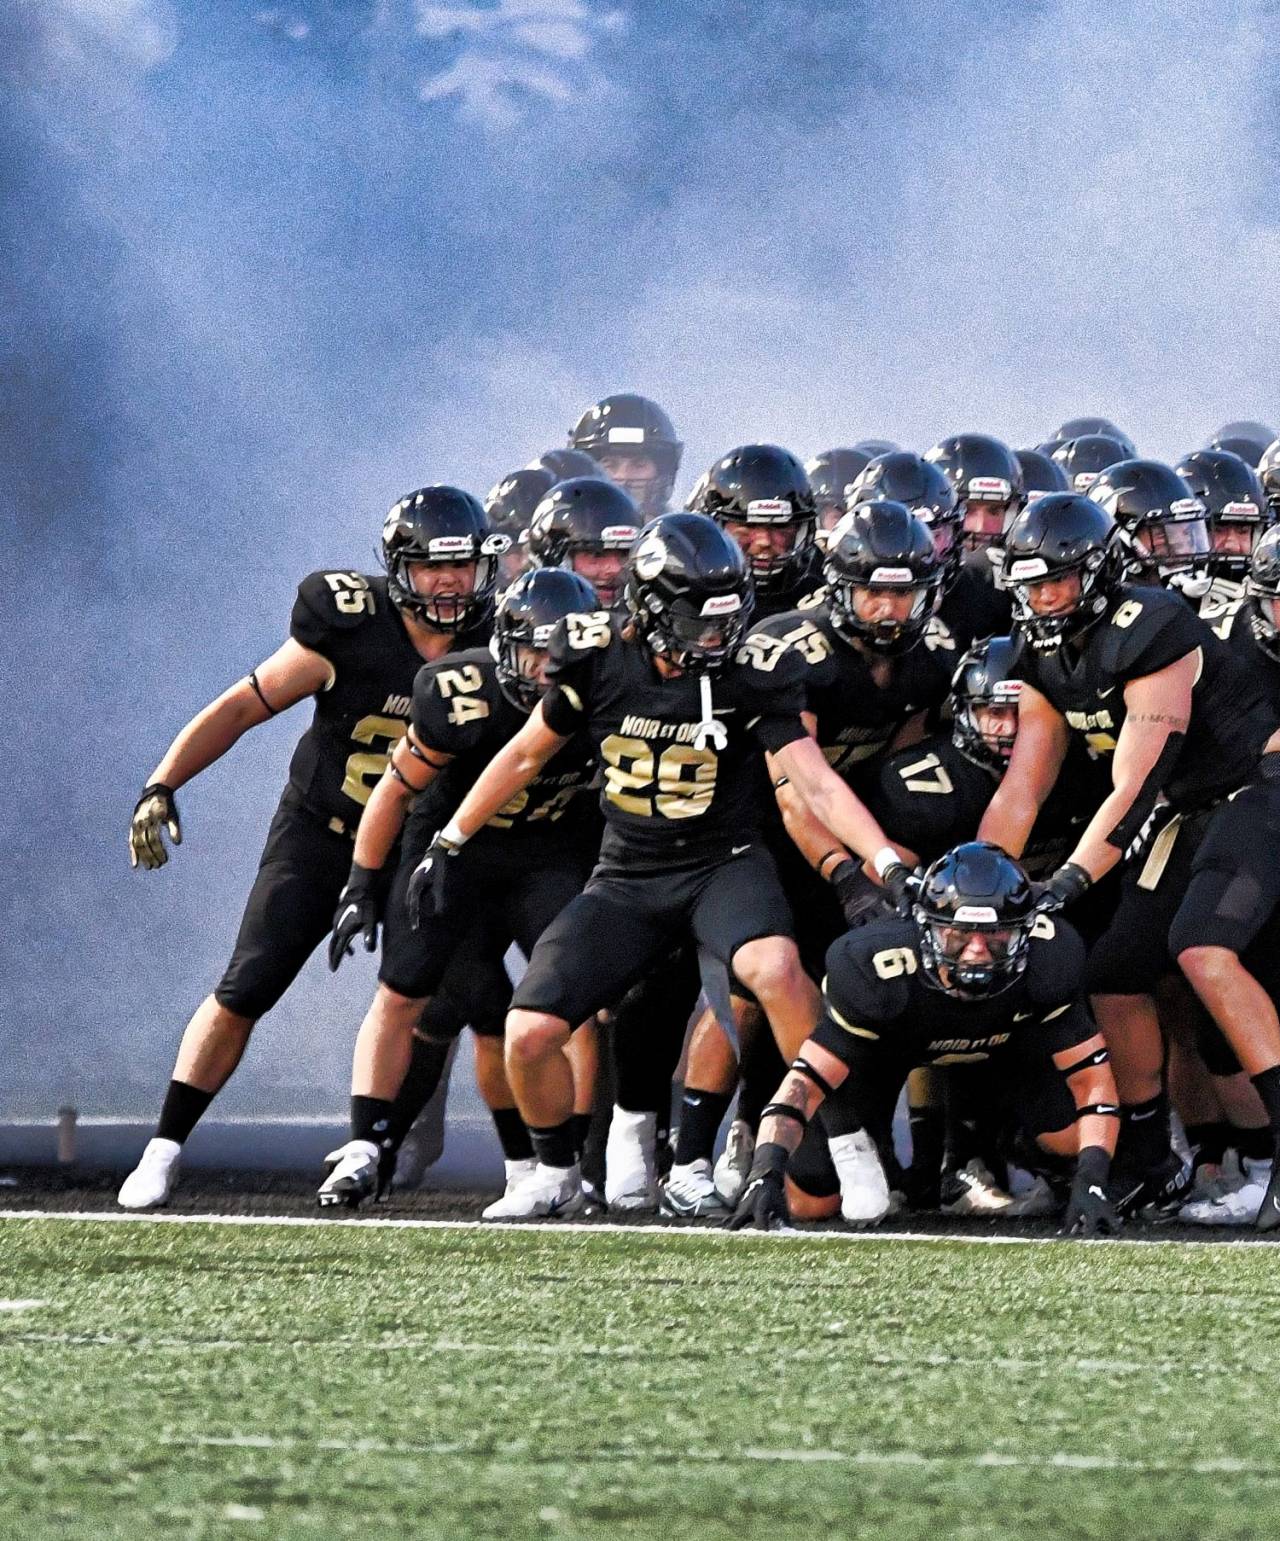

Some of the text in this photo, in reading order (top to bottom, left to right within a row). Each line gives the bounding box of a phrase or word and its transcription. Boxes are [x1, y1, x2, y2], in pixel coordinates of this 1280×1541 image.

[1230, 505, 1256, 513] Riddell
[324, 572, 376, 615] 25
[566, 611, 611, 651] 29
[435, 664, 489, 726] 24
[620, 714, 661, 737] NOIR
[660, 726, 677, 737] ET
[601, 733, 718, 820] 29
[898, 752, 954, 794] 17
[872, 946, 918, 980] 6
